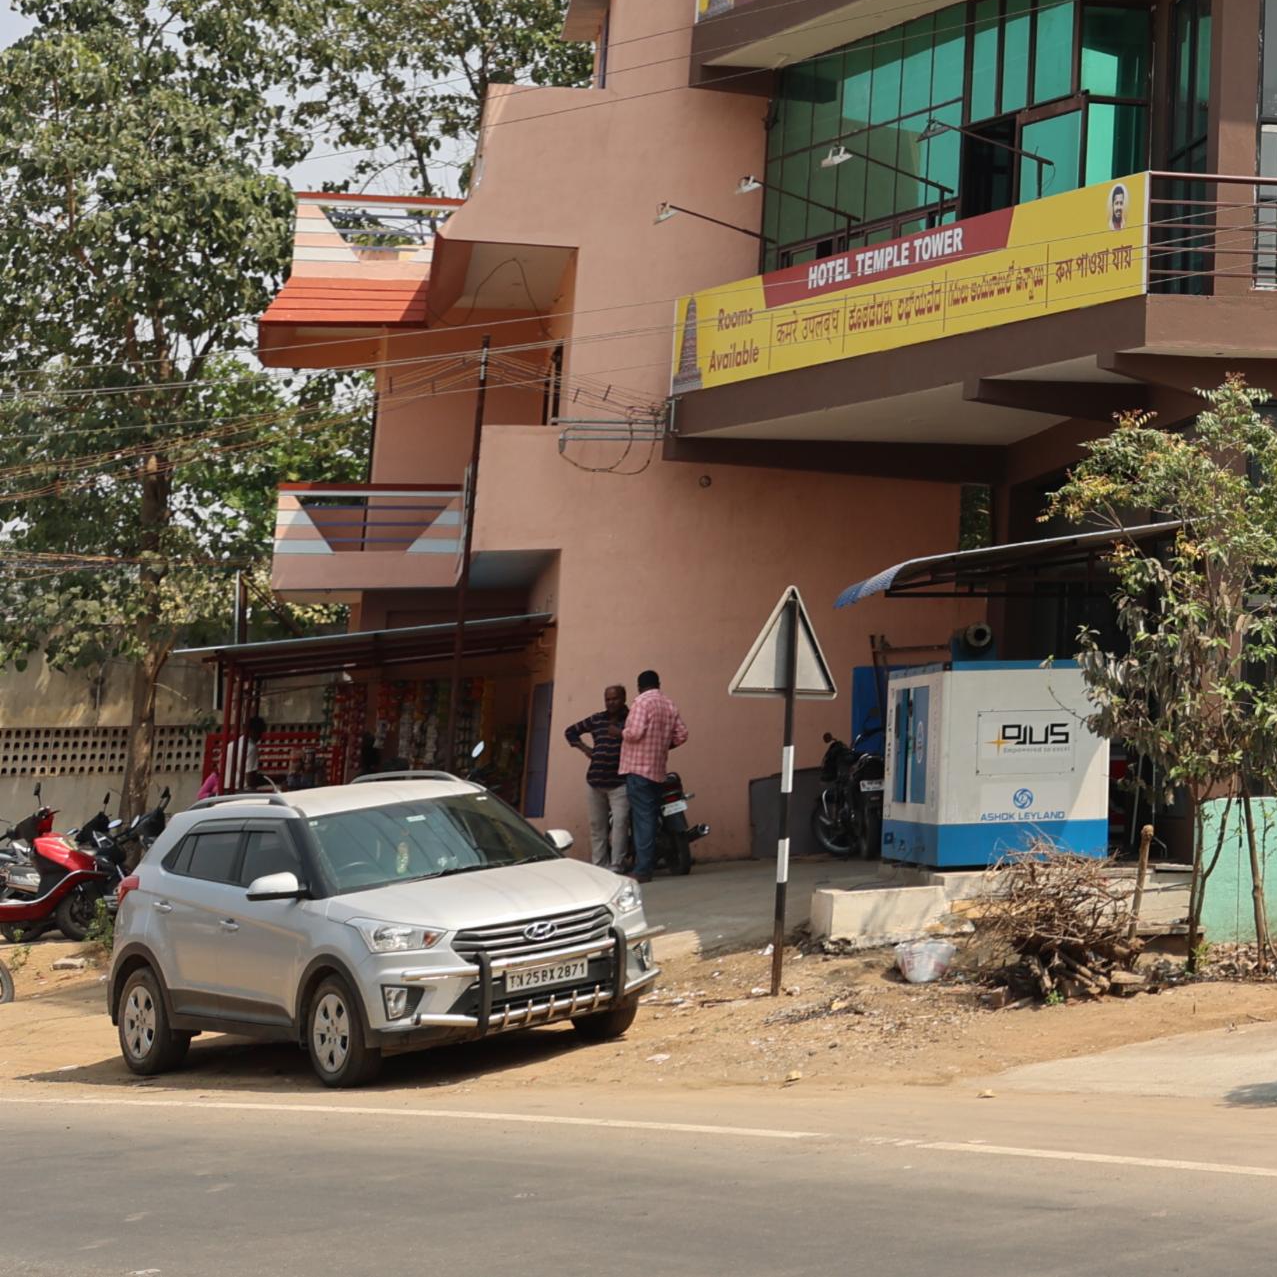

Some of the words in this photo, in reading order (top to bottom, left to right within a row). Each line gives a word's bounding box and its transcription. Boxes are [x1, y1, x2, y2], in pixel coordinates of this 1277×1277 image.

[808, 258, 852, 290] HOTEL
[856, 243, 910, 277] TEMPLE
[913, 227, 964, 262] TOWER
[1055, 258, 1074, 284] রুম
[1112, 244, 1133, 271] যায়
[717, 307, 754, 332] Rooms
[776, 310, 798, 345] कमरे
[708, 342, 760, 373] Available
[980, 812, 1016, 821] ASHOK
[1018, 811, 1065, 821] LEYLAND
